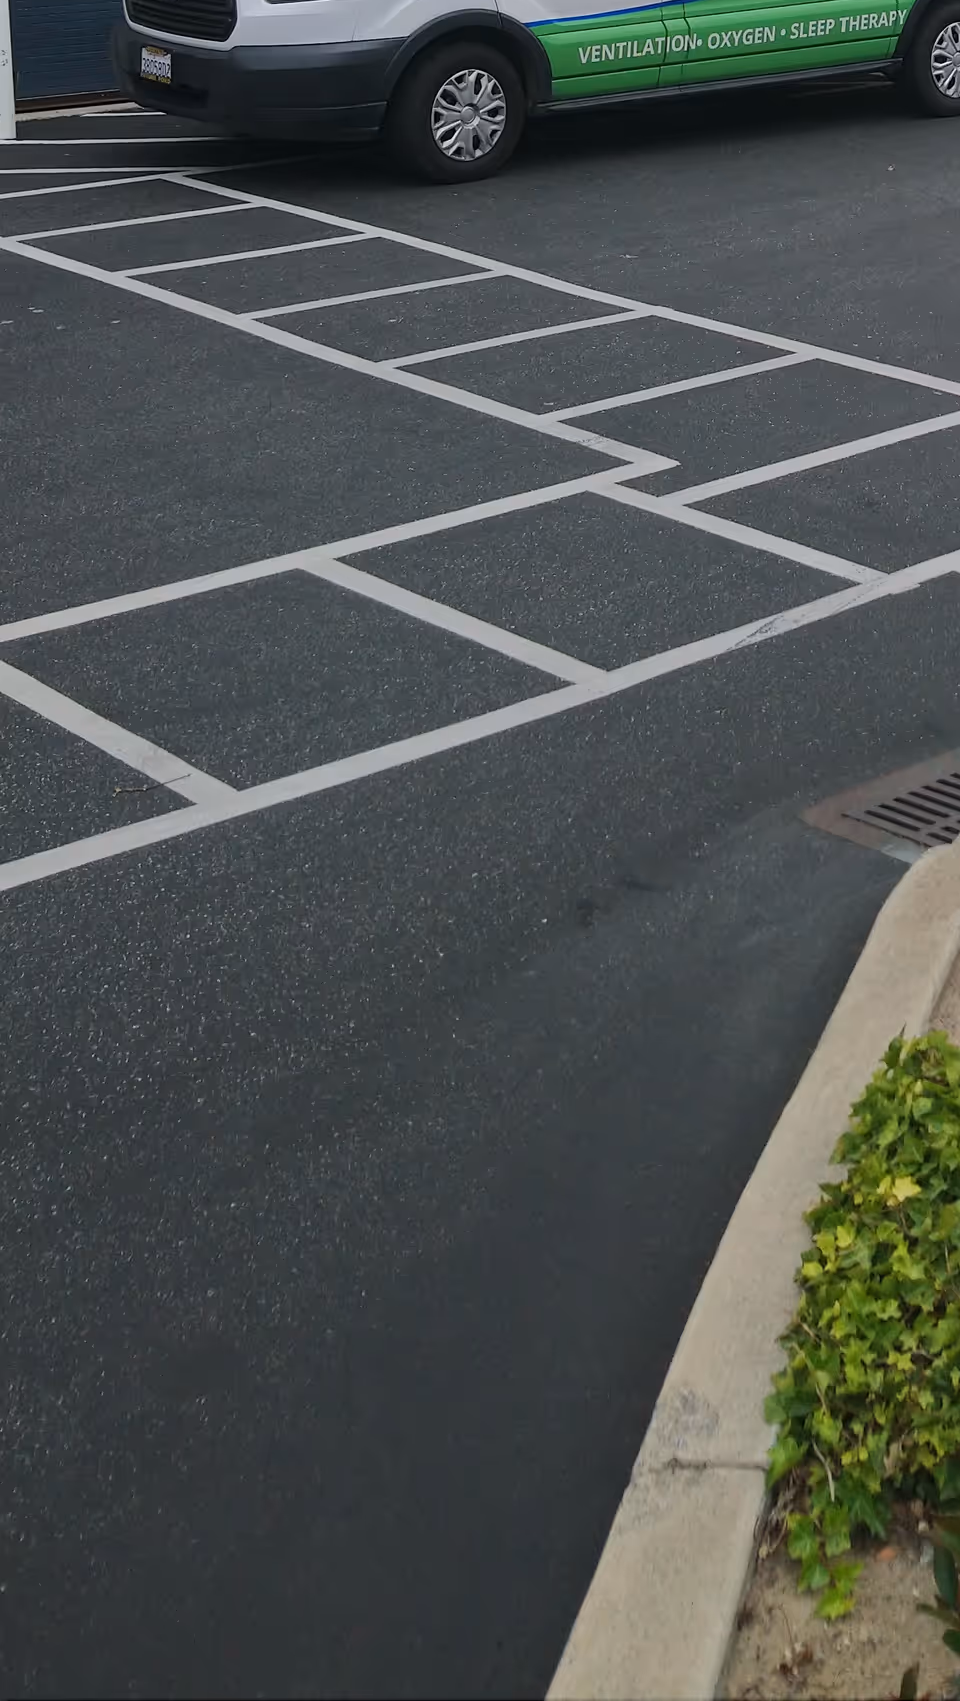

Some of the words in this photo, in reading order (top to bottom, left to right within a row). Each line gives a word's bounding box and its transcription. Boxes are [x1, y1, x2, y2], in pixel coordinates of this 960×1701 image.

[578, 32, 697, 65] VENTILATION
[707, 25, 776, 50] OXYGEN
[790, 18, 835, 40] SLEEP
[839, 9, 908, 33] THERAPY
